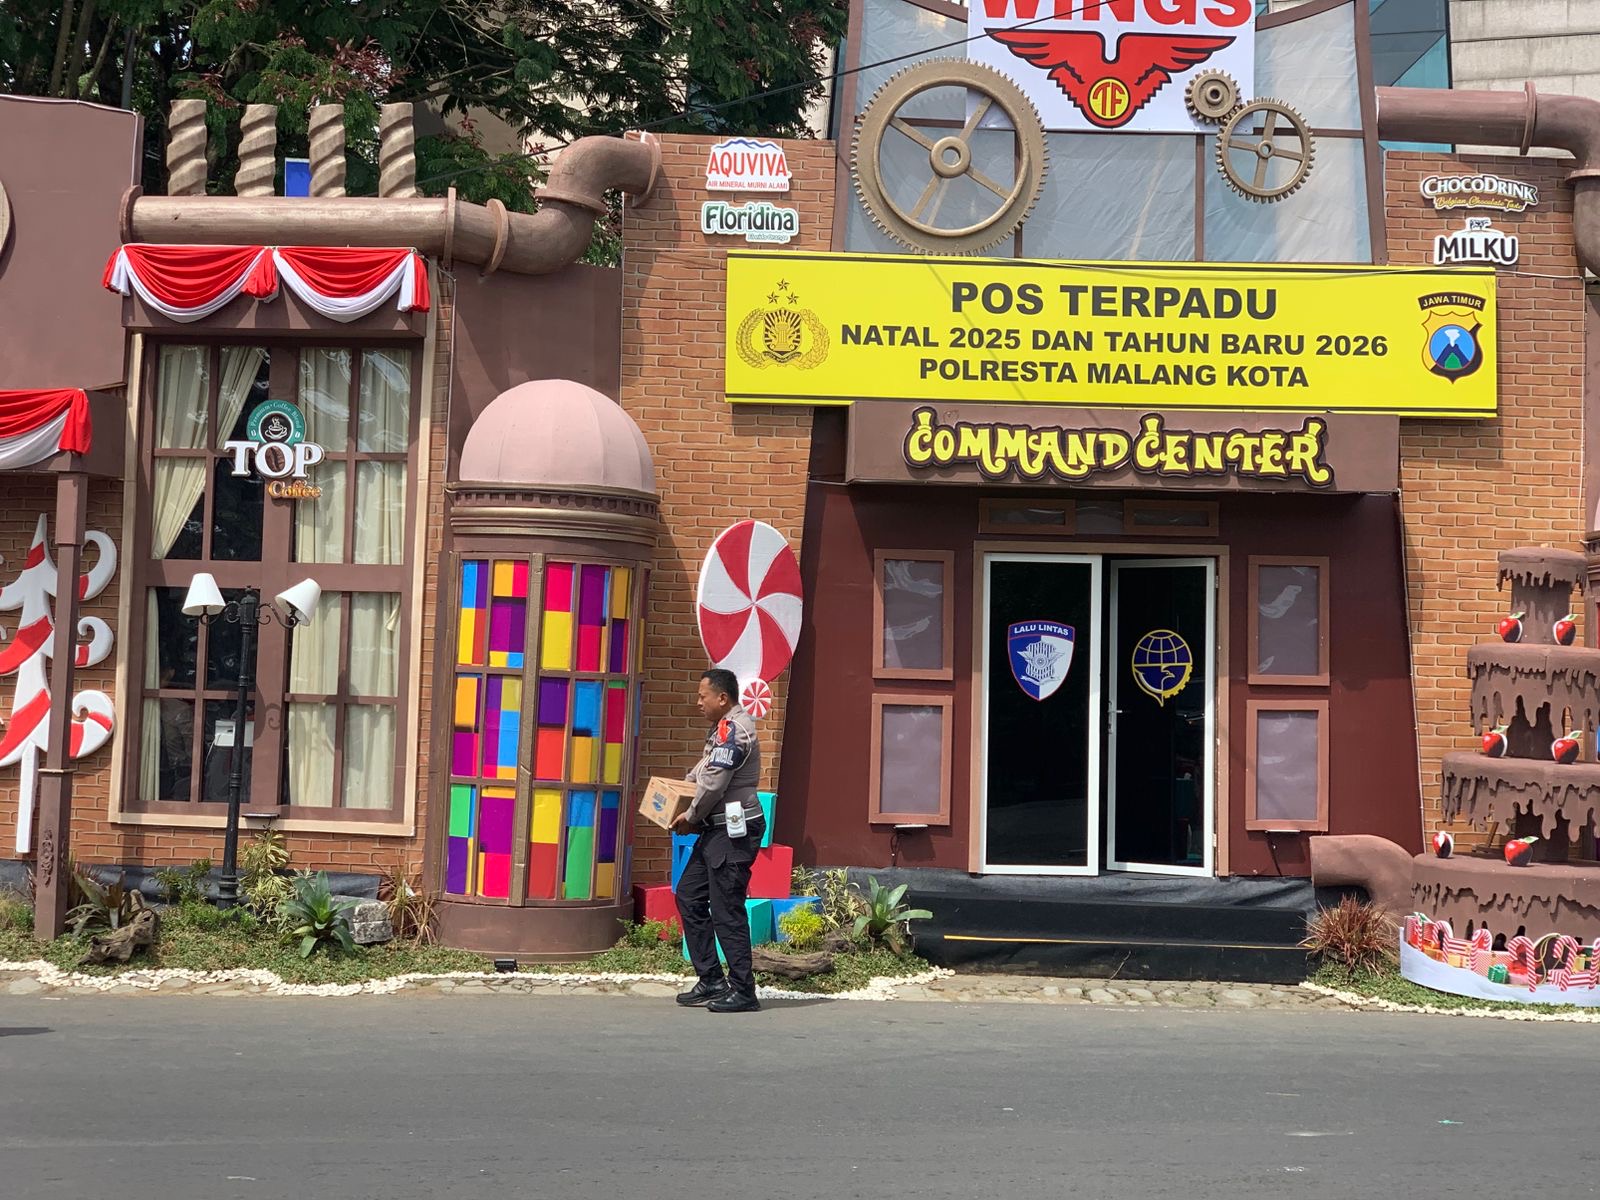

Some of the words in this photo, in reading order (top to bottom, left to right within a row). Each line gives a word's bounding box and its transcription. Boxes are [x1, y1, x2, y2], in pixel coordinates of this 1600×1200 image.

[708, 151, 787, 177] AQUVIVA
[768, 182, 788, 190] ALAMI
[1436, 196, 1467, 208] Belgian
[1468, 195, 1504, 206] Chocolate
[705, 205, 795, 231] Floridina
[1438, 237, 1517, 263] MILKU
[952, 281, 1044, 315] POS
[1060, 285, 1277, 320] TERPADU
[1423, 295, 1450, 307] JAWA
[1451, 295, 1482, 308] TIMUR
[841, 324, 939, 347] NATAL
[949, 327, 1021, 350] 2025
[1032, 330, 1094, 351] DAN
[1104, 331, 1210, 354] TAHUN
[1221, 333, 1305, 356] BARU
[1315, 334, 1388, 357] 2026
[919, 358, 1078, 384] POLRESTA
[1087, 362, 1217, 386] MALANG
[1226, 365, 1310, 388] KOTA
[223, 440, 324, 479] TOP
[909, 413, 1129, 477] COMMAND
[1136, 418, 1330, 483] CENTER
[268, 480, 323, 498] Coffee
[1014, 624, 1037, 634] LALU
[1038, 624, 1069, 636] LINTAS
